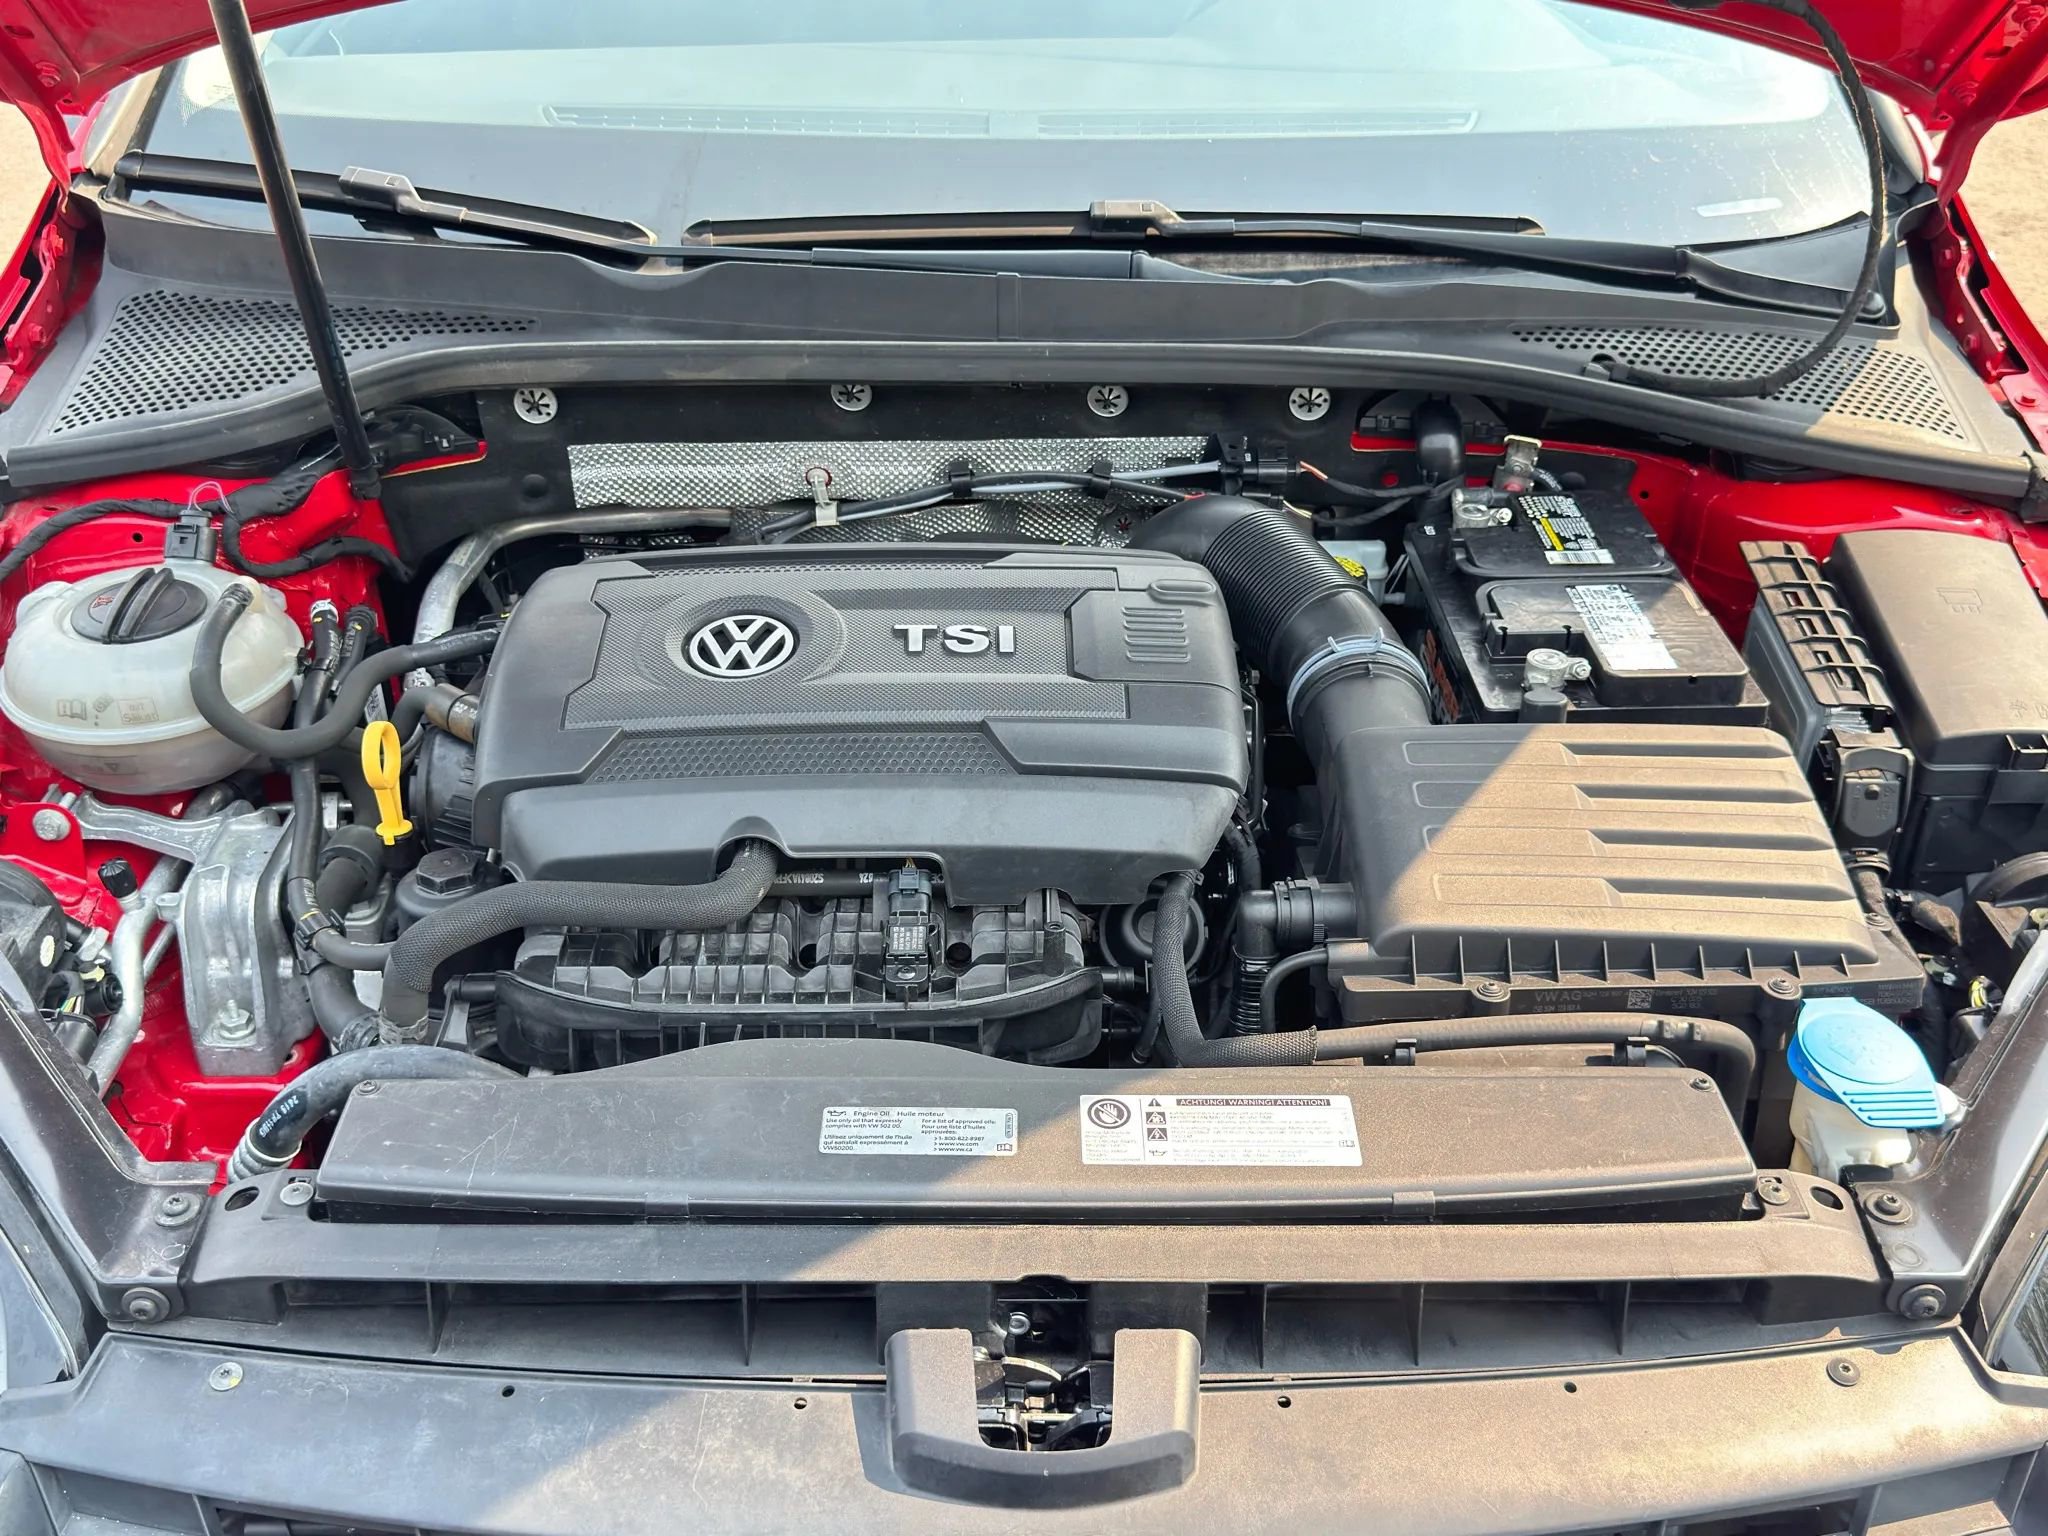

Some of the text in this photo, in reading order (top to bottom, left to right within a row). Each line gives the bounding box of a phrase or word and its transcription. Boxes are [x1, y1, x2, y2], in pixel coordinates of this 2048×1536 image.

[690, 614, 795, 677] VW
[893, 624, 1015, 654] TSI
[1534, 990, 1559, 1002] VW
[1560, 990, 1582, 1001] AG
[1275, 1099, 1328, 1107] ATTENTION!
